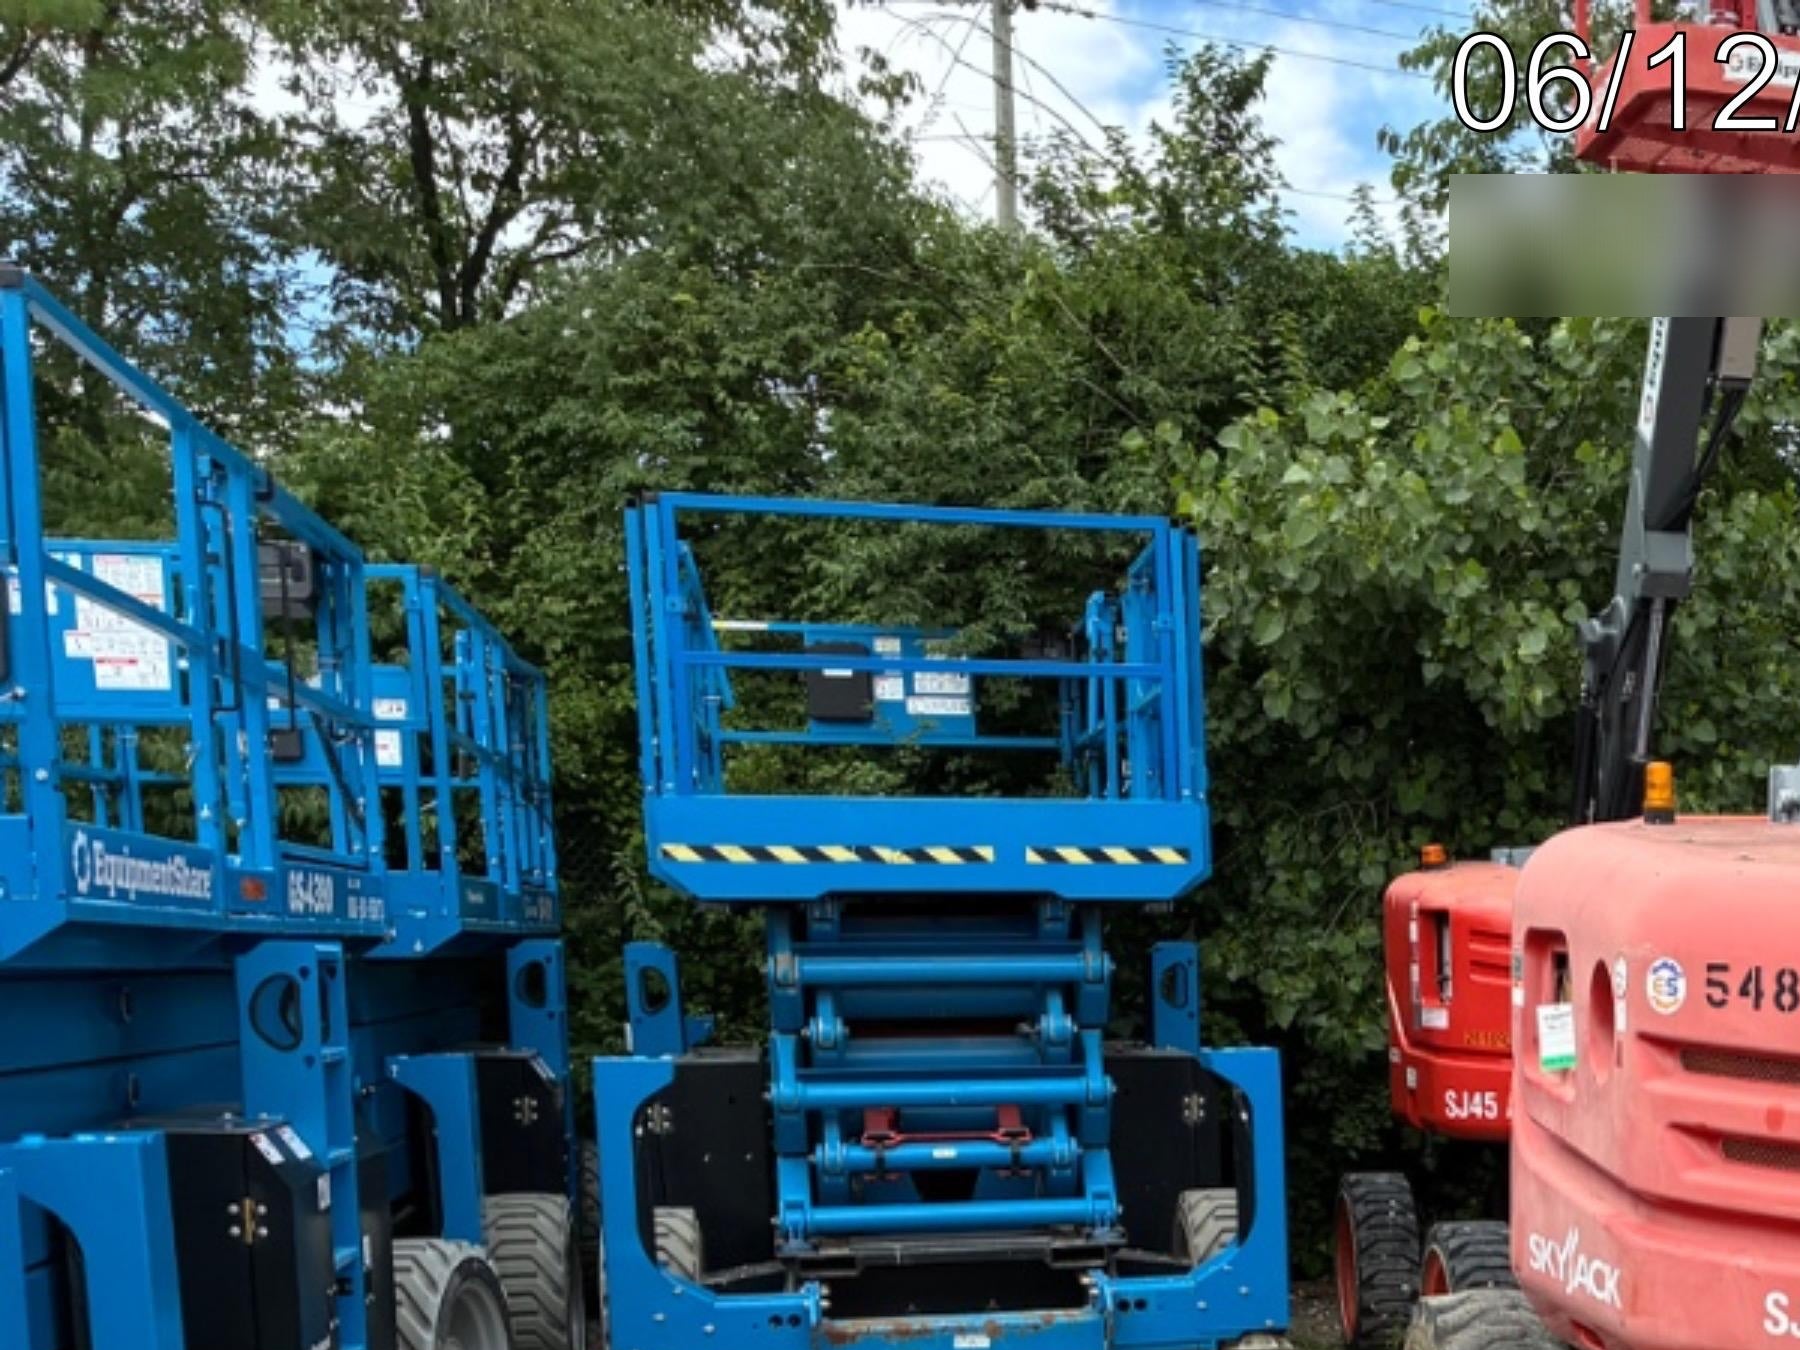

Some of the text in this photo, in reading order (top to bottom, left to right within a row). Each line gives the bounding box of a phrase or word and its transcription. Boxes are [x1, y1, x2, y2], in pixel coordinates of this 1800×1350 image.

[93, 840, 211, 900] EquipmentShare
[1444, 1089, 1498, 1120] SJ45
[1529, 1226, 1622, 1310] SKYJACK
